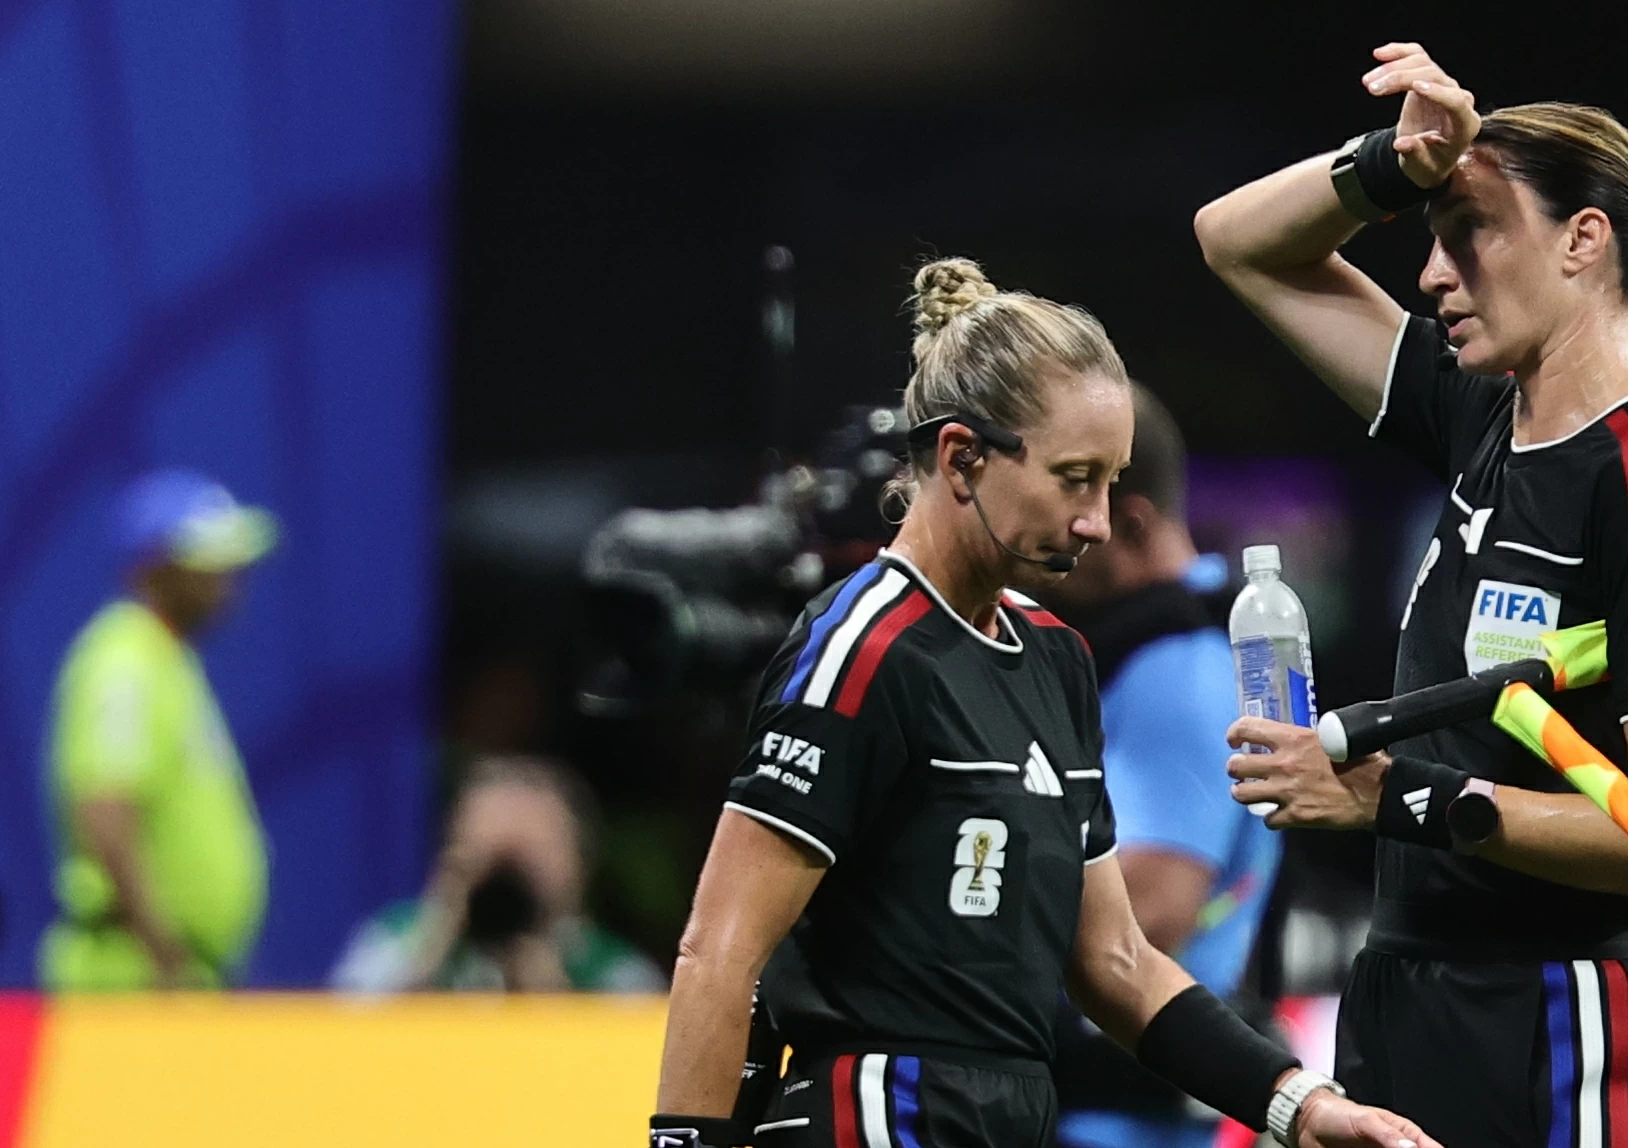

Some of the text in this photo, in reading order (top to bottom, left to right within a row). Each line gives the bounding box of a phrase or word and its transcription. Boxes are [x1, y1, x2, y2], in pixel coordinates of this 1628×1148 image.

[1478, 589, 1547, 626] FIFA
[1474, 631, 1542, 652] ASSISTANT
[762, 731, 821, 776] FIFA
[781, 772, 813, 795] ONE
[964, 895, 987, 907] FIFA
